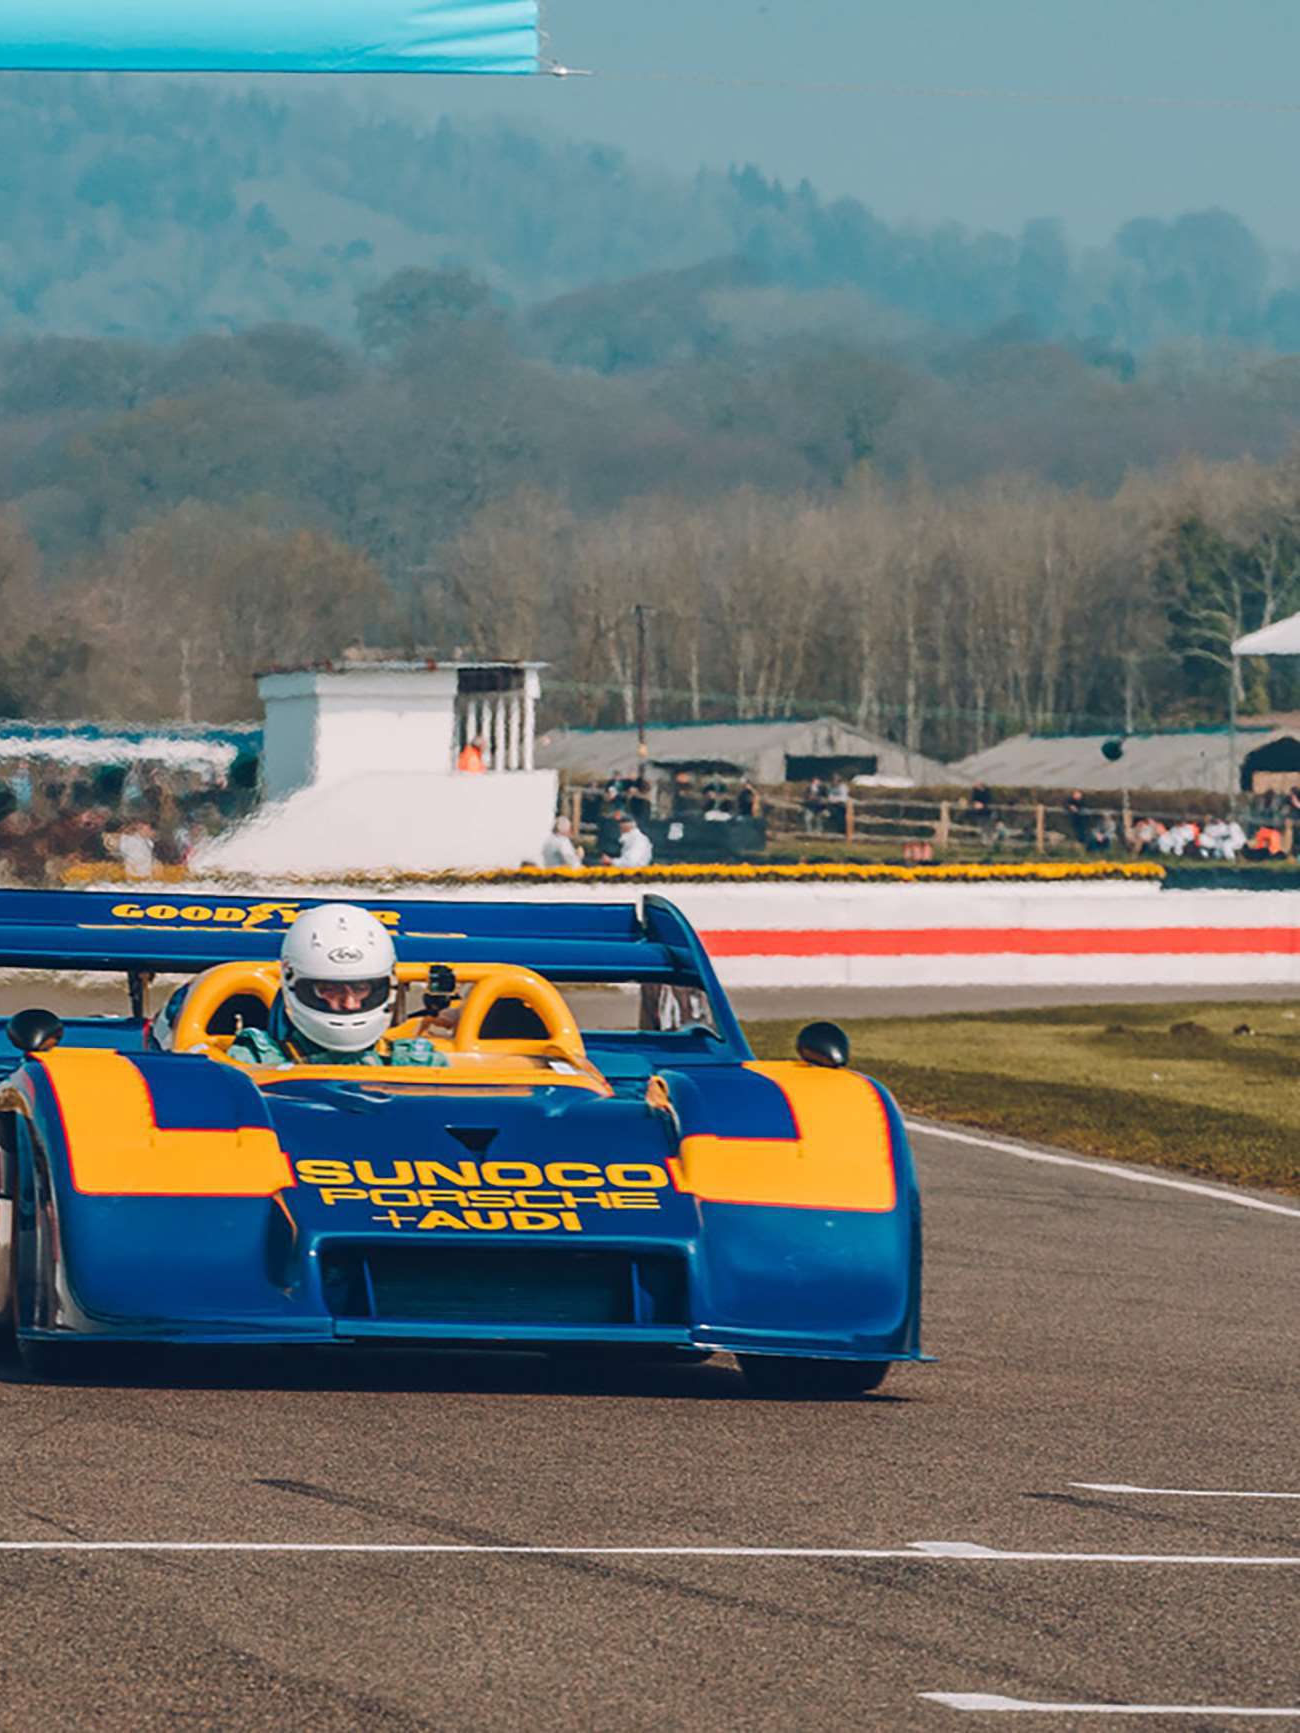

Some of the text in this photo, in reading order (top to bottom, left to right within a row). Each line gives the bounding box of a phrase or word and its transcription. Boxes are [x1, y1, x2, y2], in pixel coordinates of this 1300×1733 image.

[111, 903, 401, 927] GOODYR
[295, 1159, 669, 1189] SUNOCO
[319, 1187, 662, 1210] PORSCHE
[372, 1209, 583, 1231] +AUDI
